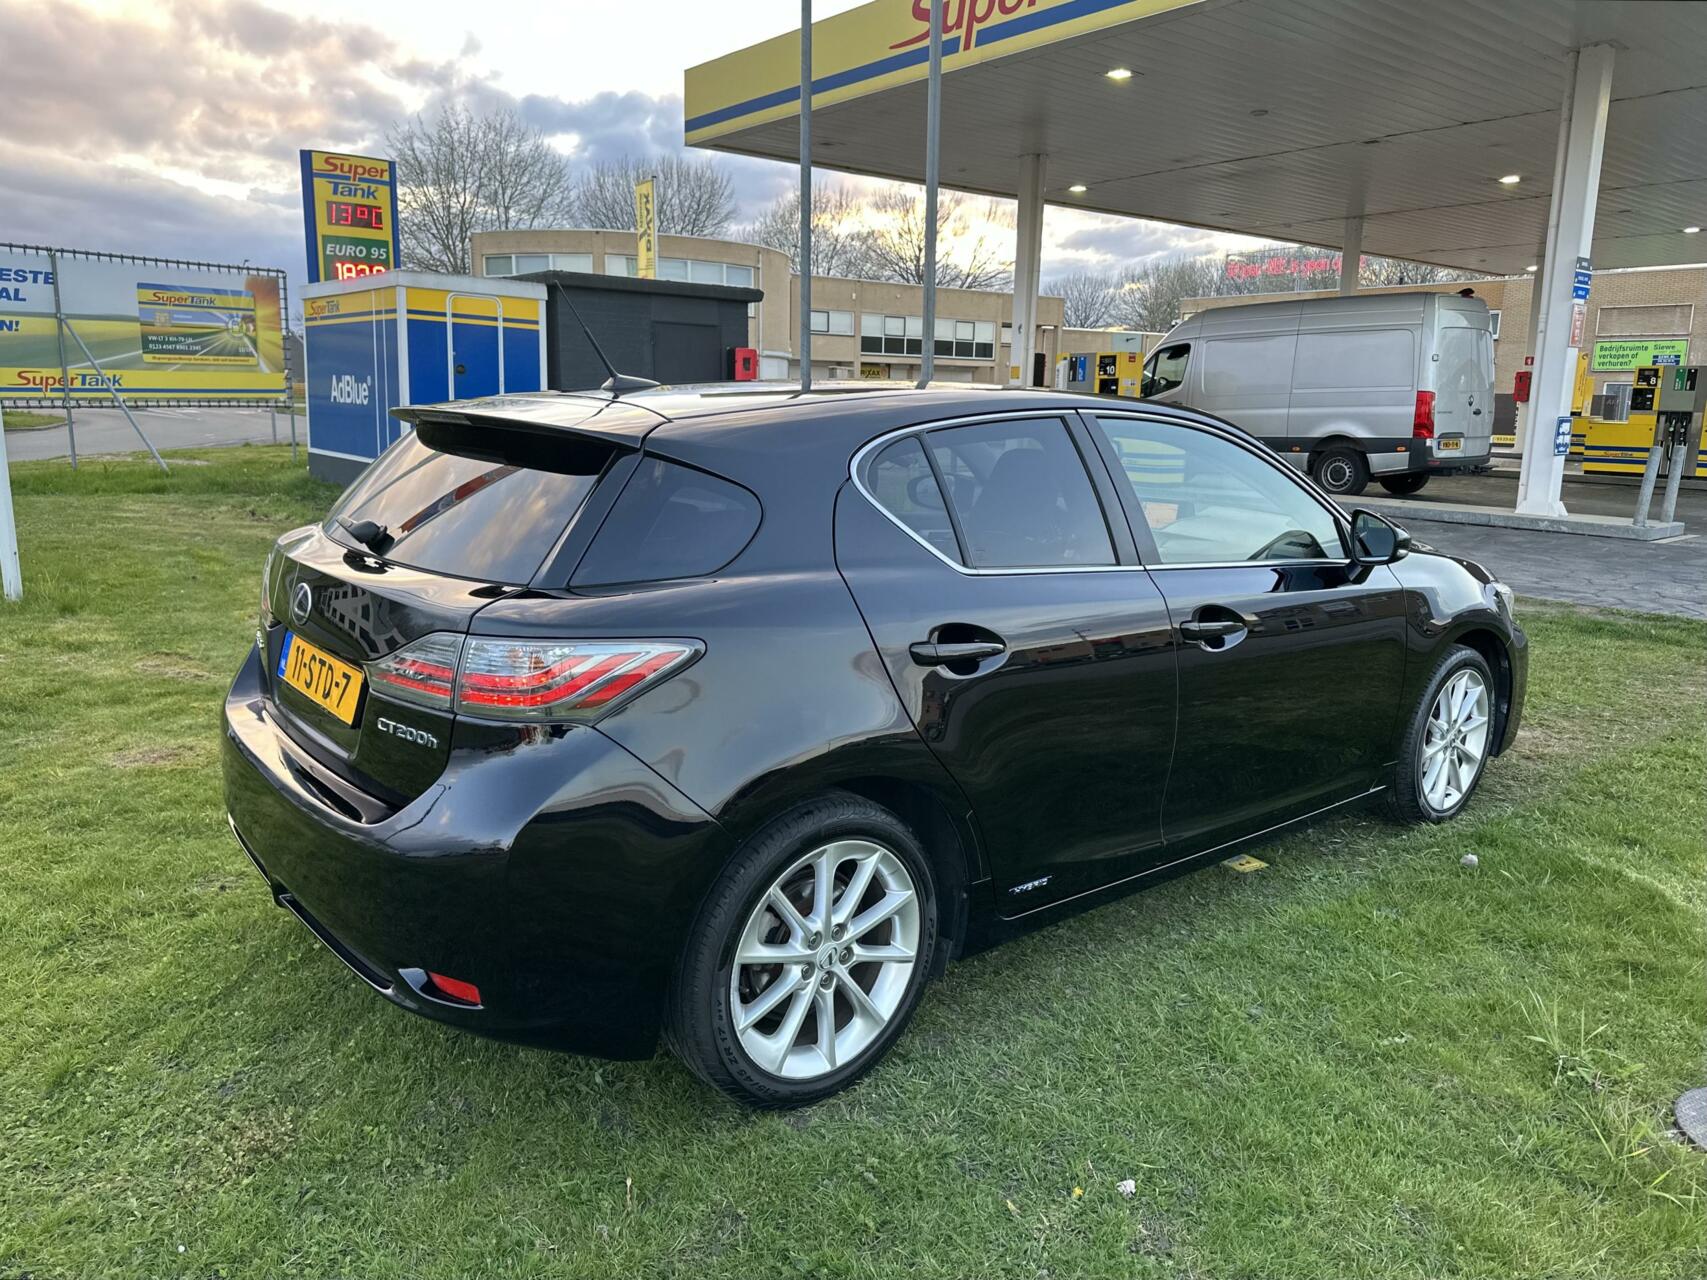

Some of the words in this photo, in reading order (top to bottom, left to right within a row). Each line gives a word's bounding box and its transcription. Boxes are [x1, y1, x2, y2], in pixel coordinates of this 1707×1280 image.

[889, 0, 1037, 51] Sup
[312, 155, 388, 182] Super
[326, 181, 378, 200] Tank
[326, 243, 367, 258] EURO
[370, 247, 387, 259] 95
[152, 291, 217, 307] SuperTank
[1598, 352, 1630, 361] verkopen
[1630, 352, 1638, 360] of
[1599, 344, 1649, 353] Bedrijfsruimte
[1106, 365, 1115, 375] 10
[1597, 359, 1632, 367] verhuren?
[8, 370, 123, 392] SuperTank
[1650, 377, 1656, 385] 8
[291, 644, 352, 709] 11-STD-7
[376, 717, 438, 749] CT200h
